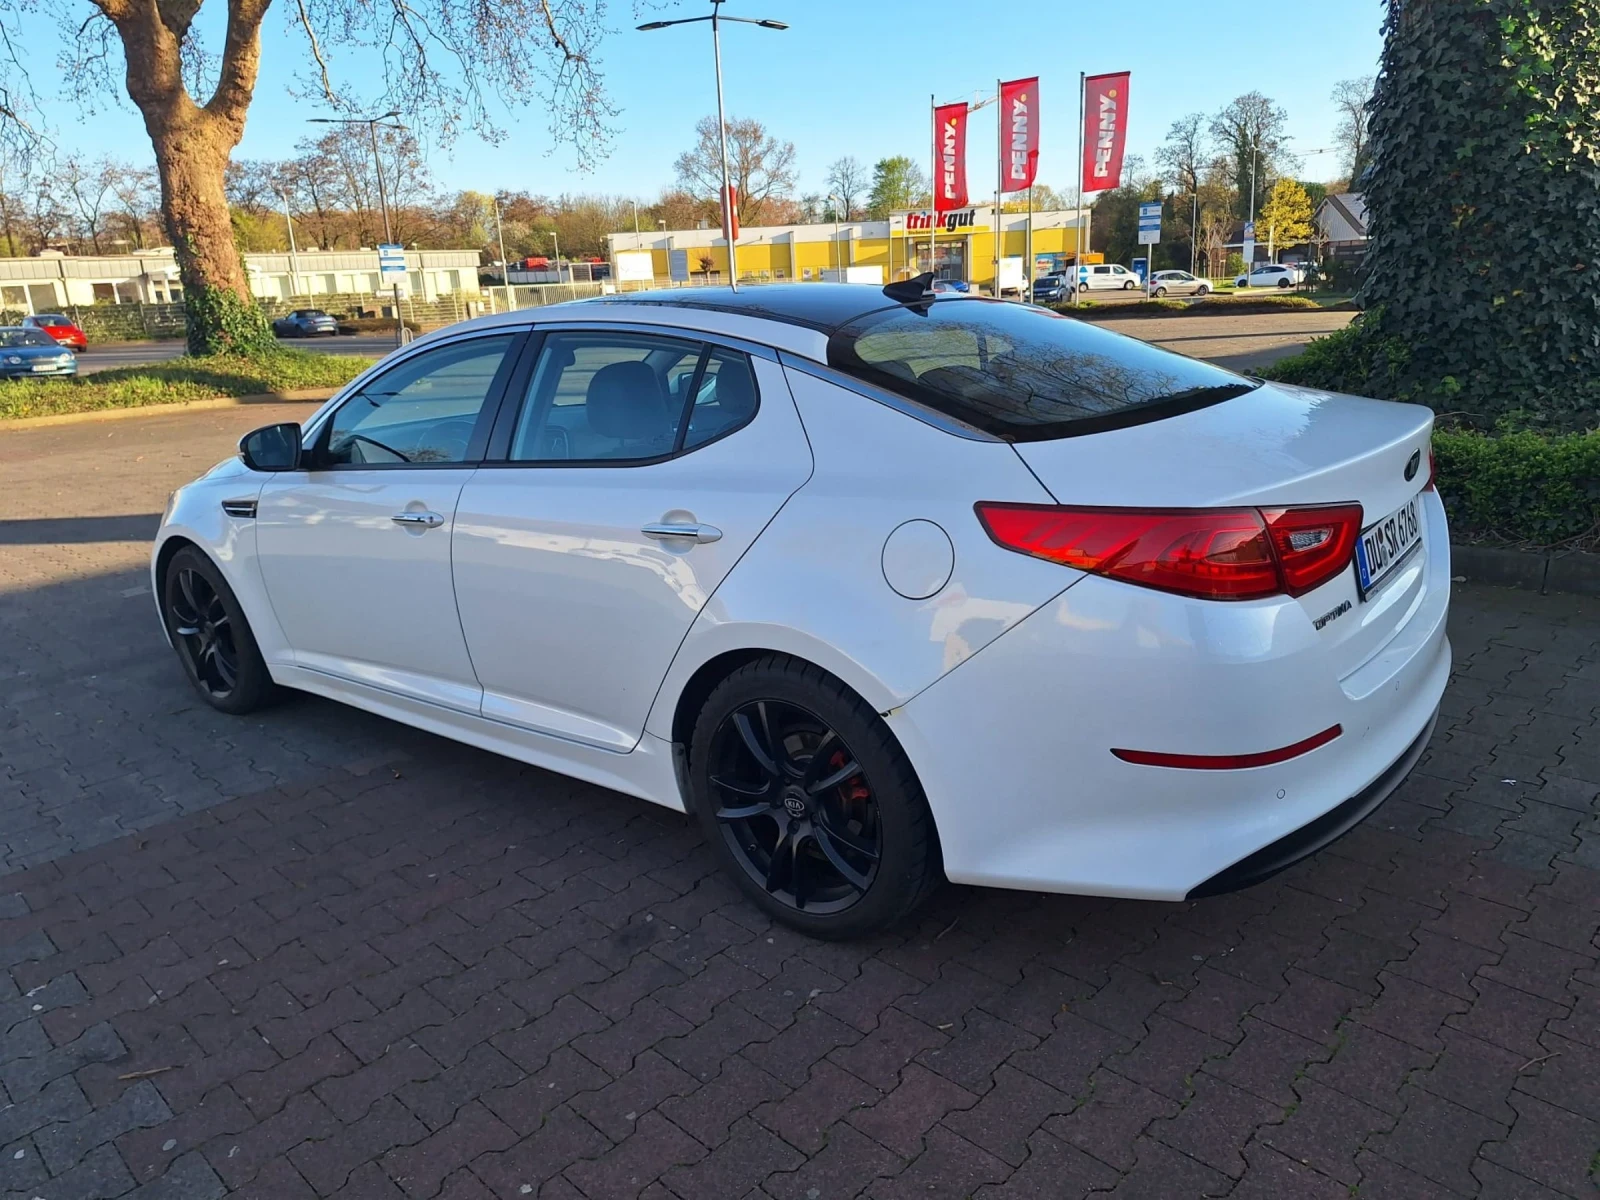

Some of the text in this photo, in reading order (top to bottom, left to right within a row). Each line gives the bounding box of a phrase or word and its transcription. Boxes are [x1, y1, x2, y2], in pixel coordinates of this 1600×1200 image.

[1365, 500, 1418, 576] DU SR 6768
[786, 799, 802, 810] KIA
